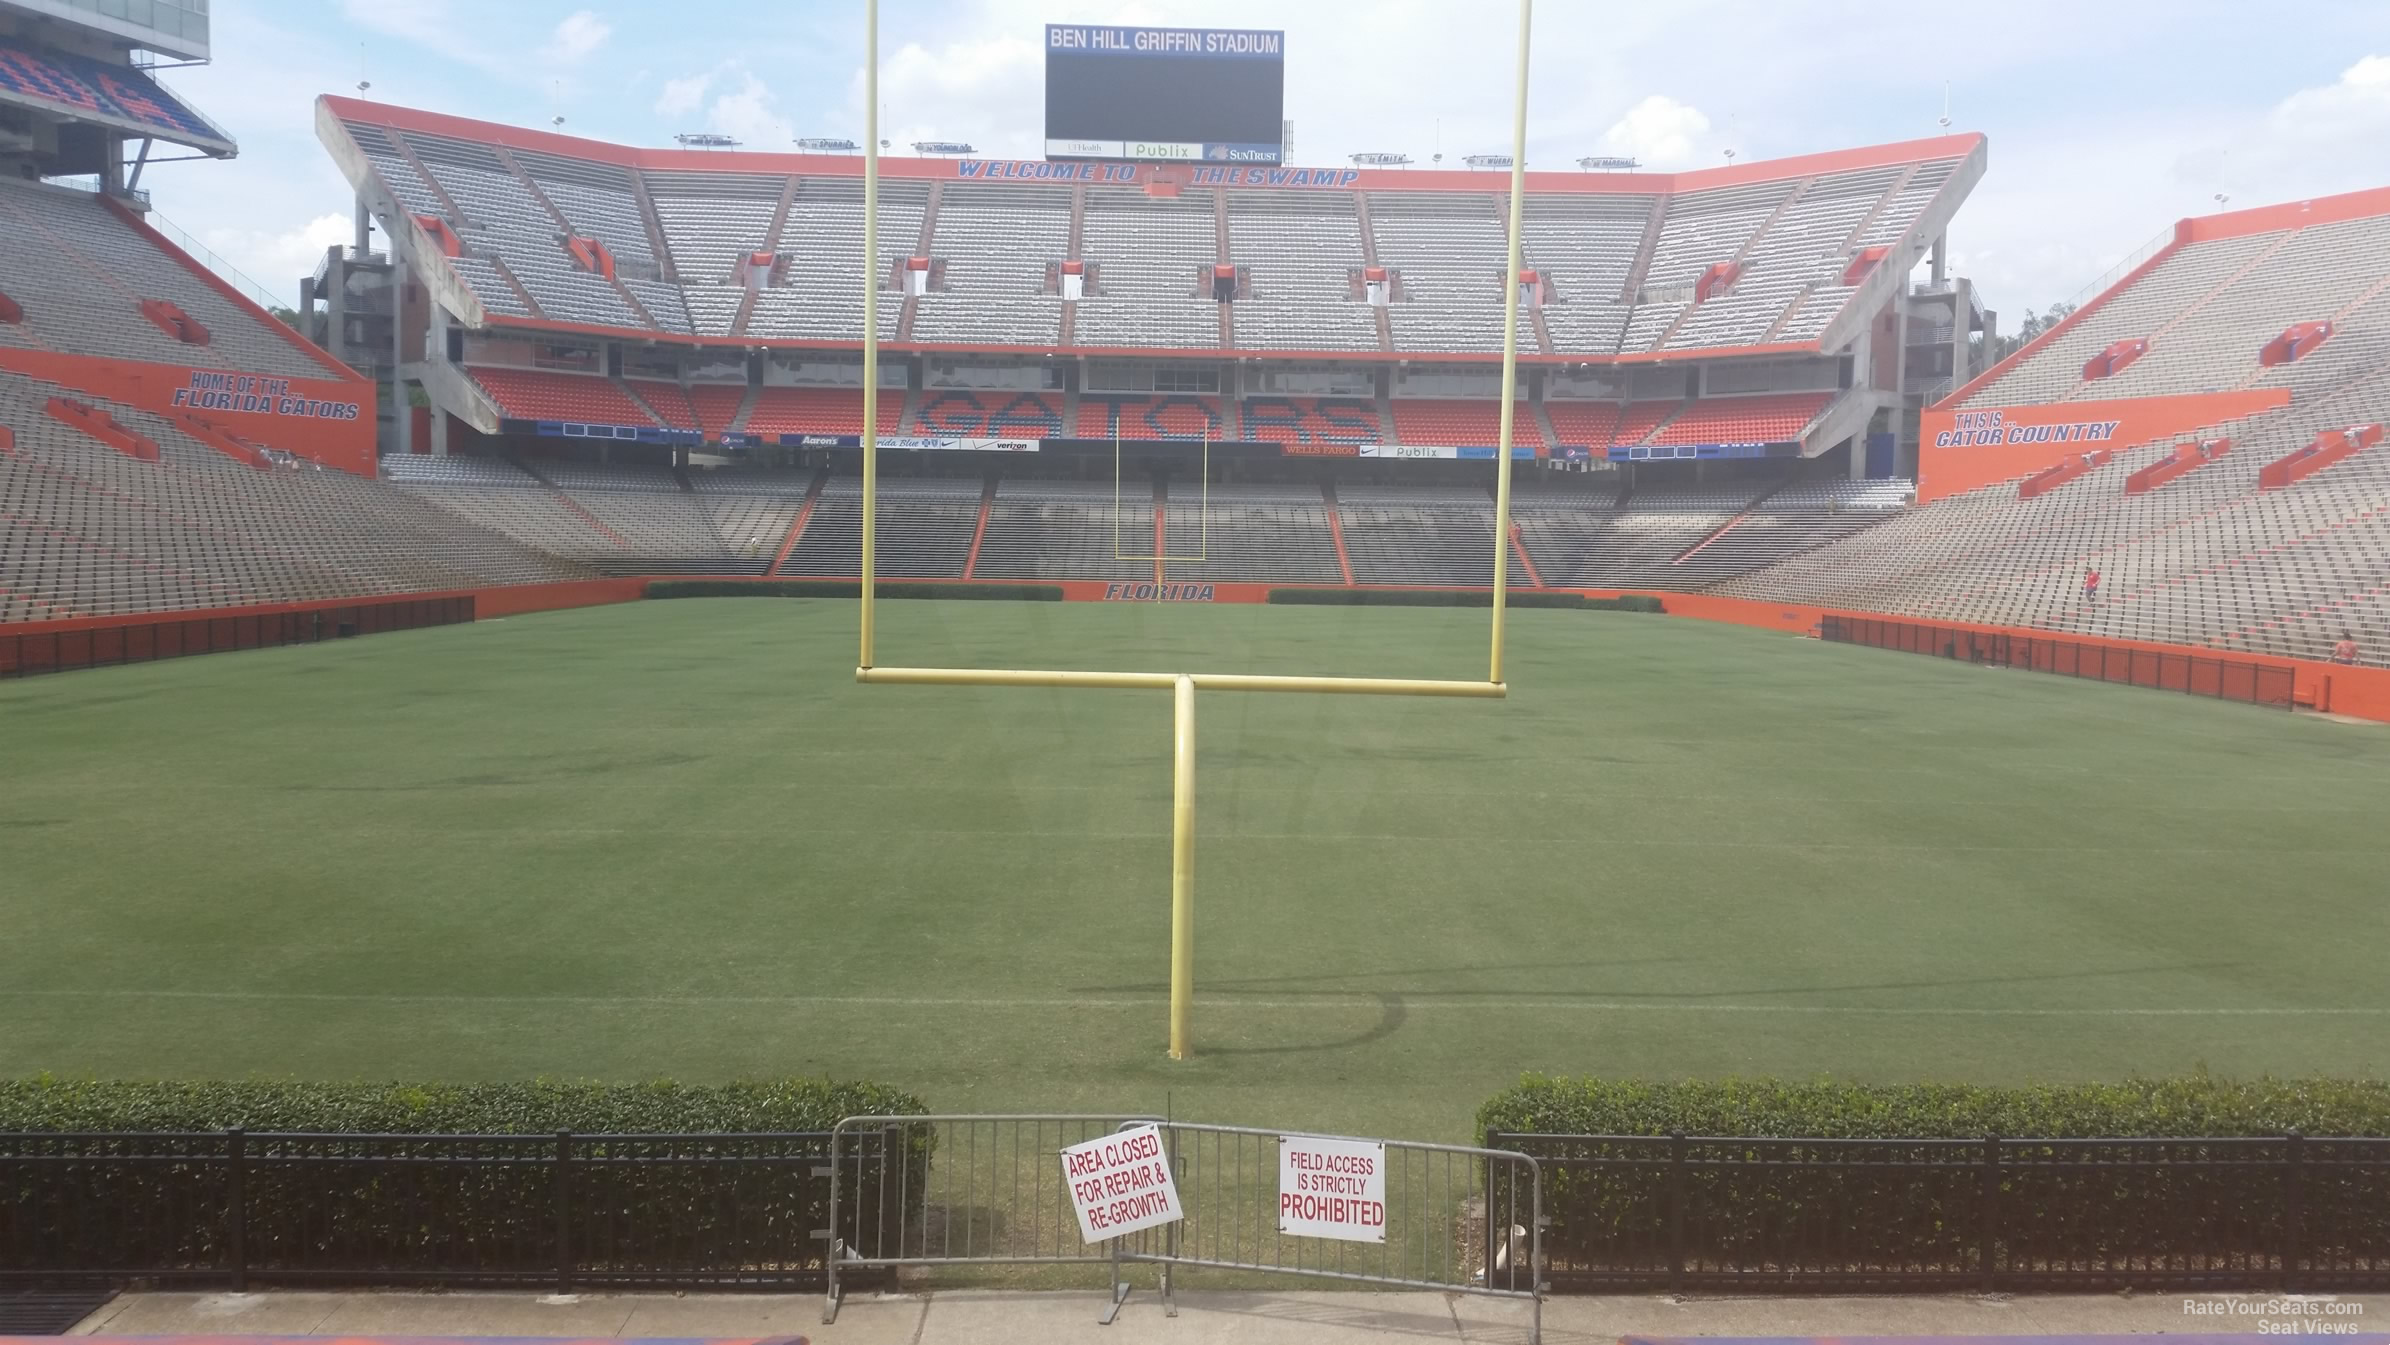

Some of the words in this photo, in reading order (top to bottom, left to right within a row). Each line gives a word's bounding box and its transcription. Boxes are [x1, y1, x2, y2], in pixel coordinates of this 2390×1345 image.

[1051, 28, 1087, 48] BEN
[1092, 29, 1130, 50] HILL
[1135, 31, 1201, 51] GRIFFIN
[1206, 33, 1279, 53] STADIUM
[819, 140, 855, 149] SPURRIER
[1136, 144, 1189, 158] Publix
[1377, 155, 1403, 163] SMITH
[958, 160, 1098, 181] WELCOME
[1102, 164, 1137, 182] TO
[1192, 166, 1242, 184] THE
[1246, 167, 1359, 187] SWAMP
[189, 371, 234, 391] HOME
[237, 375, 256, 394] OF
[171, 388, 271, 413] FLORIDA
[278, 398, 360, 420] GATORS
[1955, 412, 1987, 430] THIS
[802, 435, 838, 446] Aaron's
[899, 438, 919, 447] Blue
[1935, 428, 2003, 448] GATOR
[2007, 420, 2121, 445] COUNTRY
[997, 441, 1027, 451] verizon
[1287, 446, 1321, 455] WELLS
[1323, 447, 1357, 455] FARGO
[1396, 447, 1437, 457] Publix
[1103, 583, 1215, 601] FLORIDA
[1069, 1149, 1104, 1178] AREA
[1105, 1134, 1159, 1167] CLOSED
[1290, 1152, 1323, 1171] FIELD
[1325, 1155, 1374, 1175] ACCESS
[1075, 1178, 1105, 1205] FOR
[1106, 1166, 1152, 1197] REPAIR
[1154, 1162, 1167, 1184] &
[1297, 1173, 1308, 1190] IS
[1311, 1174, 1367, 1196] STRICTLY
[1088, 1190, 1169, 1231] RE-GROWTH
[1281, 1193, 1384, 1227] PROHIBITED
